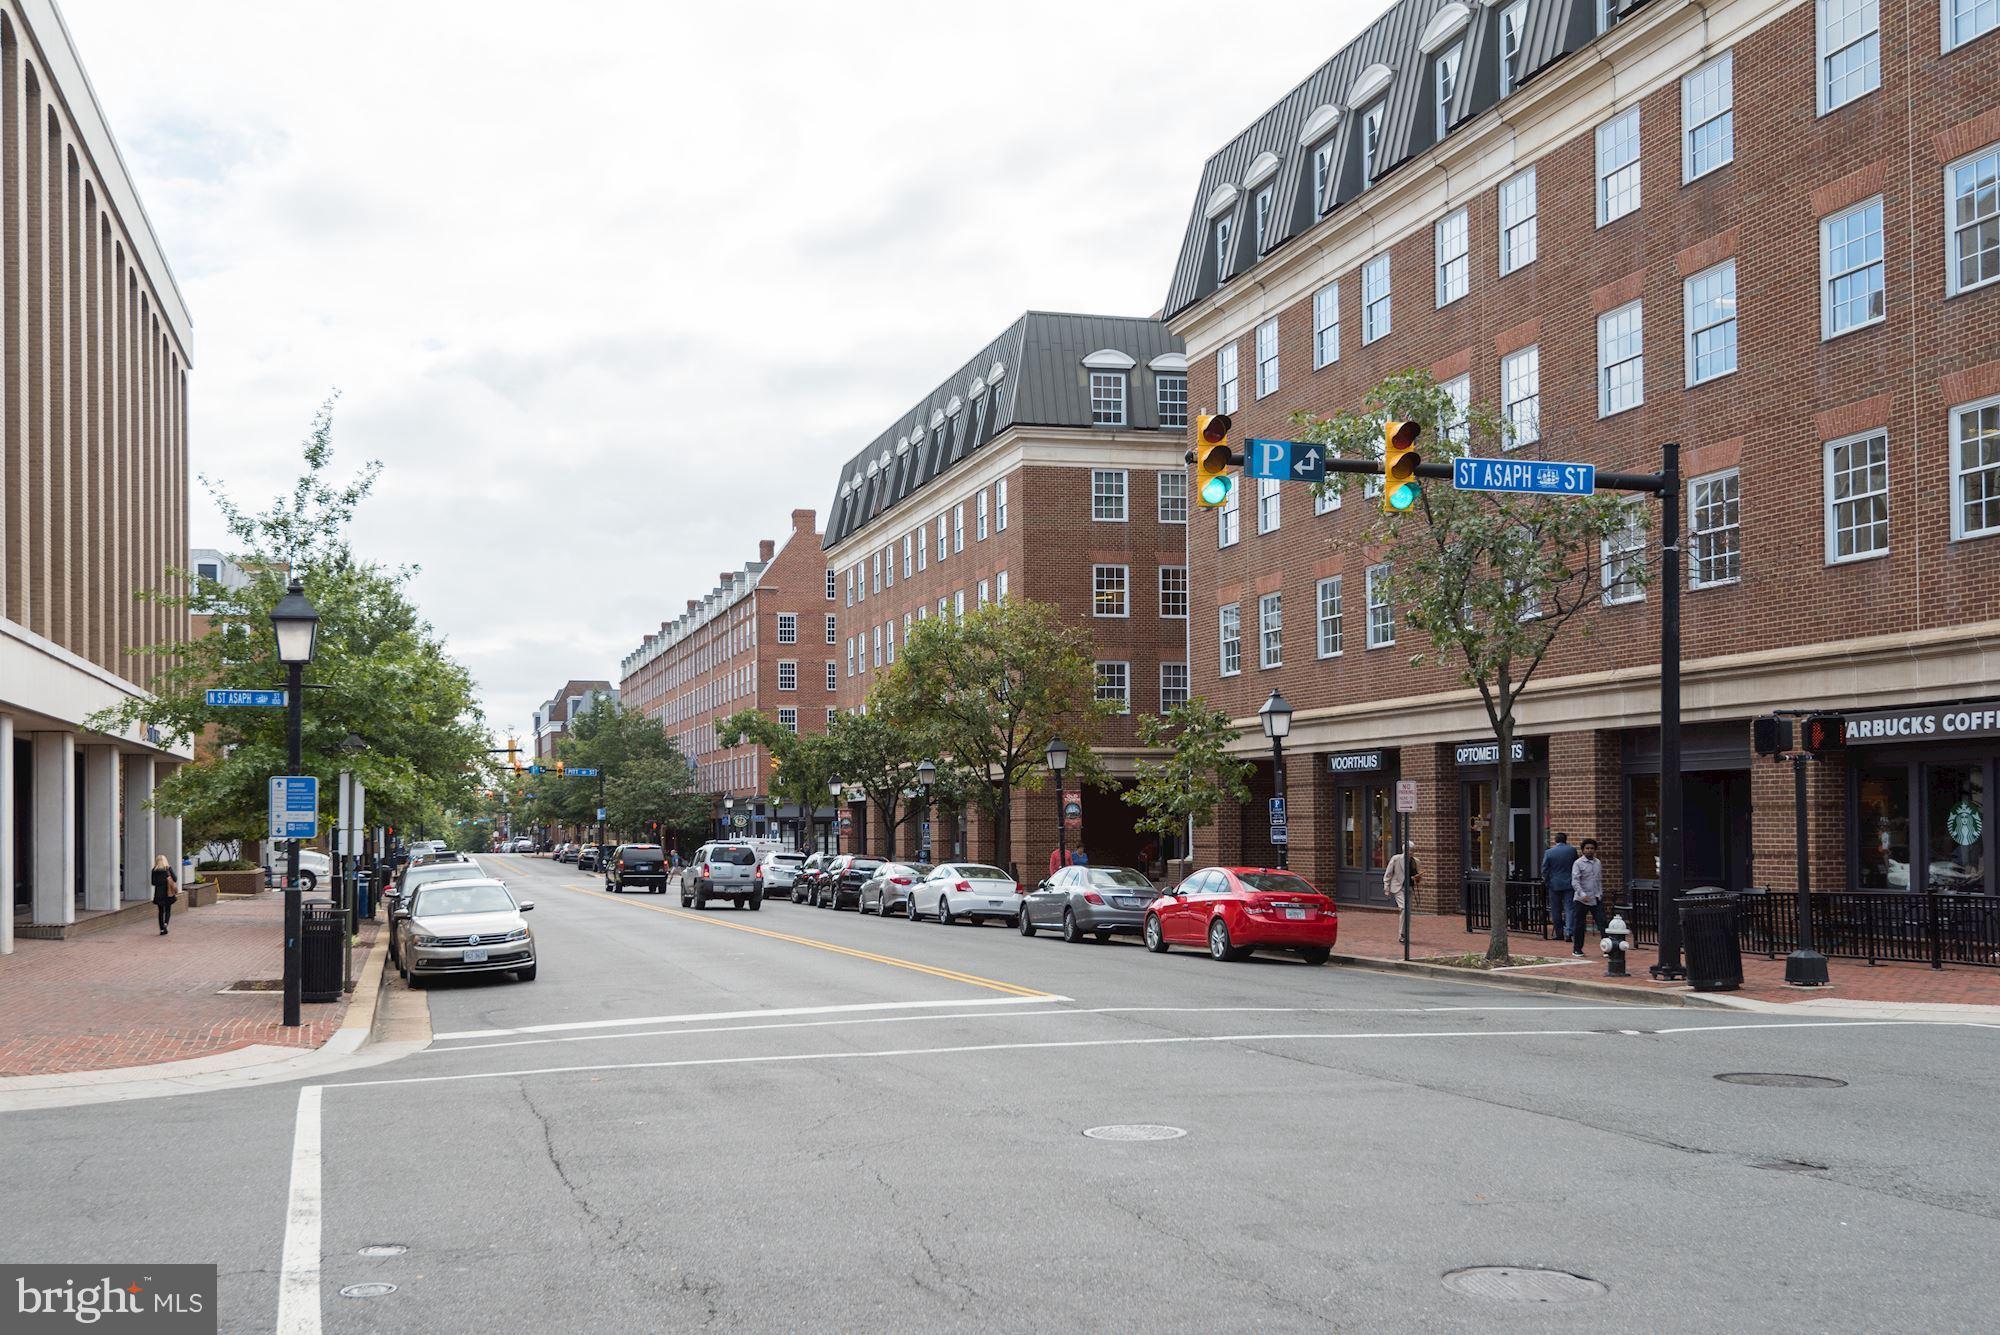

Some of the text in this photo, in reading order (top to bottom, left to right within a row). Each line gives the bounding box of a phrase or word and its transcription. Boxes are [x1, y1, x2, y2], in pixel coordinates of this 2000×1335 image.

[1259, 443, 1285, 476] P
[1460, 462, 1587, 490] ST ASAPH ST
[209, 692, 215, 704] N
[218, 692, 226, 704] ST
[228, 692, 252, 705] ASAPH
[1845, 711, 2000, 738] ARBUCKS COFF
[1331, 755, 1378, 770] VOORTHUIS
[1456, 744, 1523, 763] OPTOMETTS
[1274, 800, 1280, 808] P
